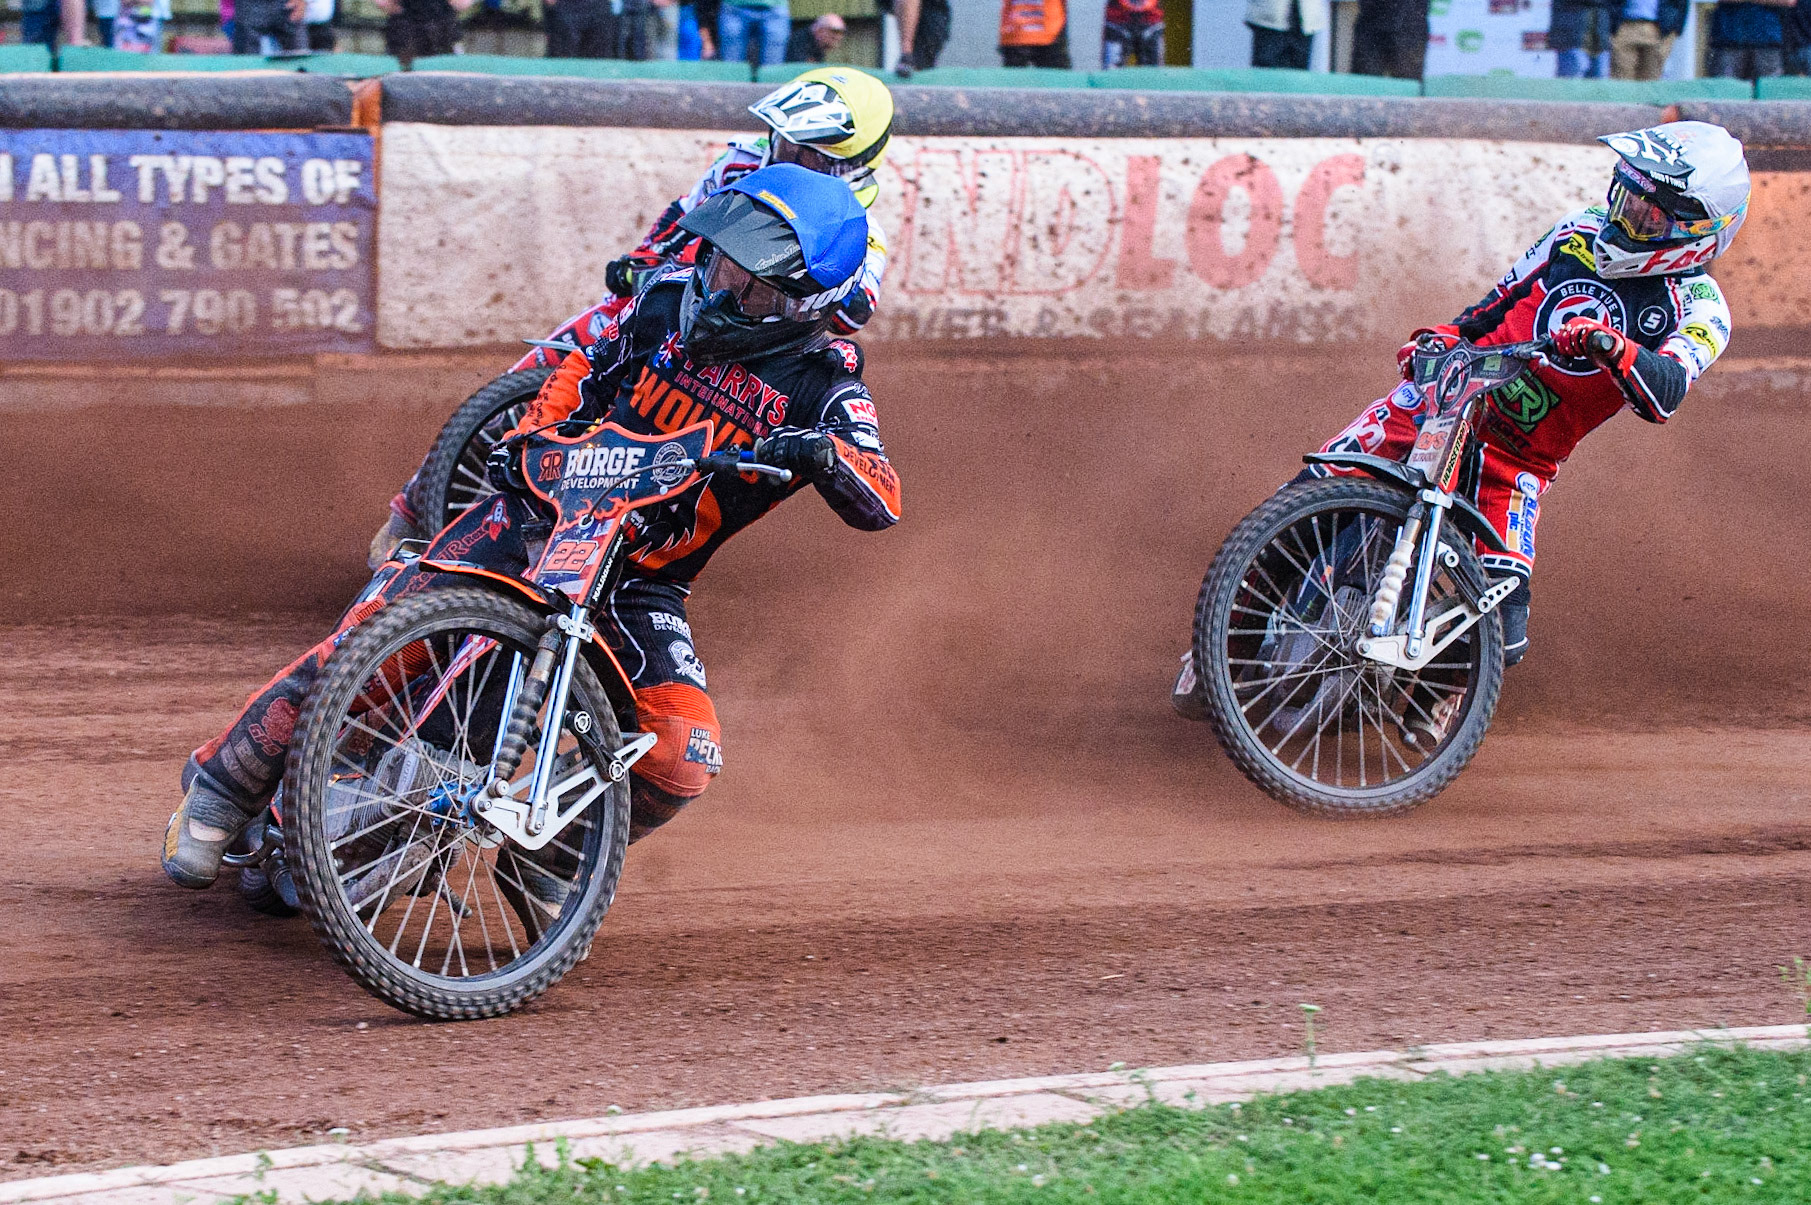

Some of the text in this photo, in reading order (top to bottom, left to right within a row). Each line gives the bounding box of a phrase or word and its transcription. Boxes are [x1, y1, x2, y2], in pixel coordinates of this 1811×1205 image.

[25, 153, 122, 203] ALL
[129, 154, 289, 205] TYPES
[301, 158, 362, 205] OF
[155, 221, 196, 270] &
[211, 220, 358, 270] GATES
[1560, 283, 1597, 298] BELLE
[160, 288, 256, 336] 790
[674, 371, 769, 440] INTERNATIONA
[684, 359, 790, 427] ARRYS
[849, 401, 877, 419] NG
[564, 446, 647, 478] BORGE
[1508, 511, 1521, 531] plc
[690, 728, 711, 740] LUKE
